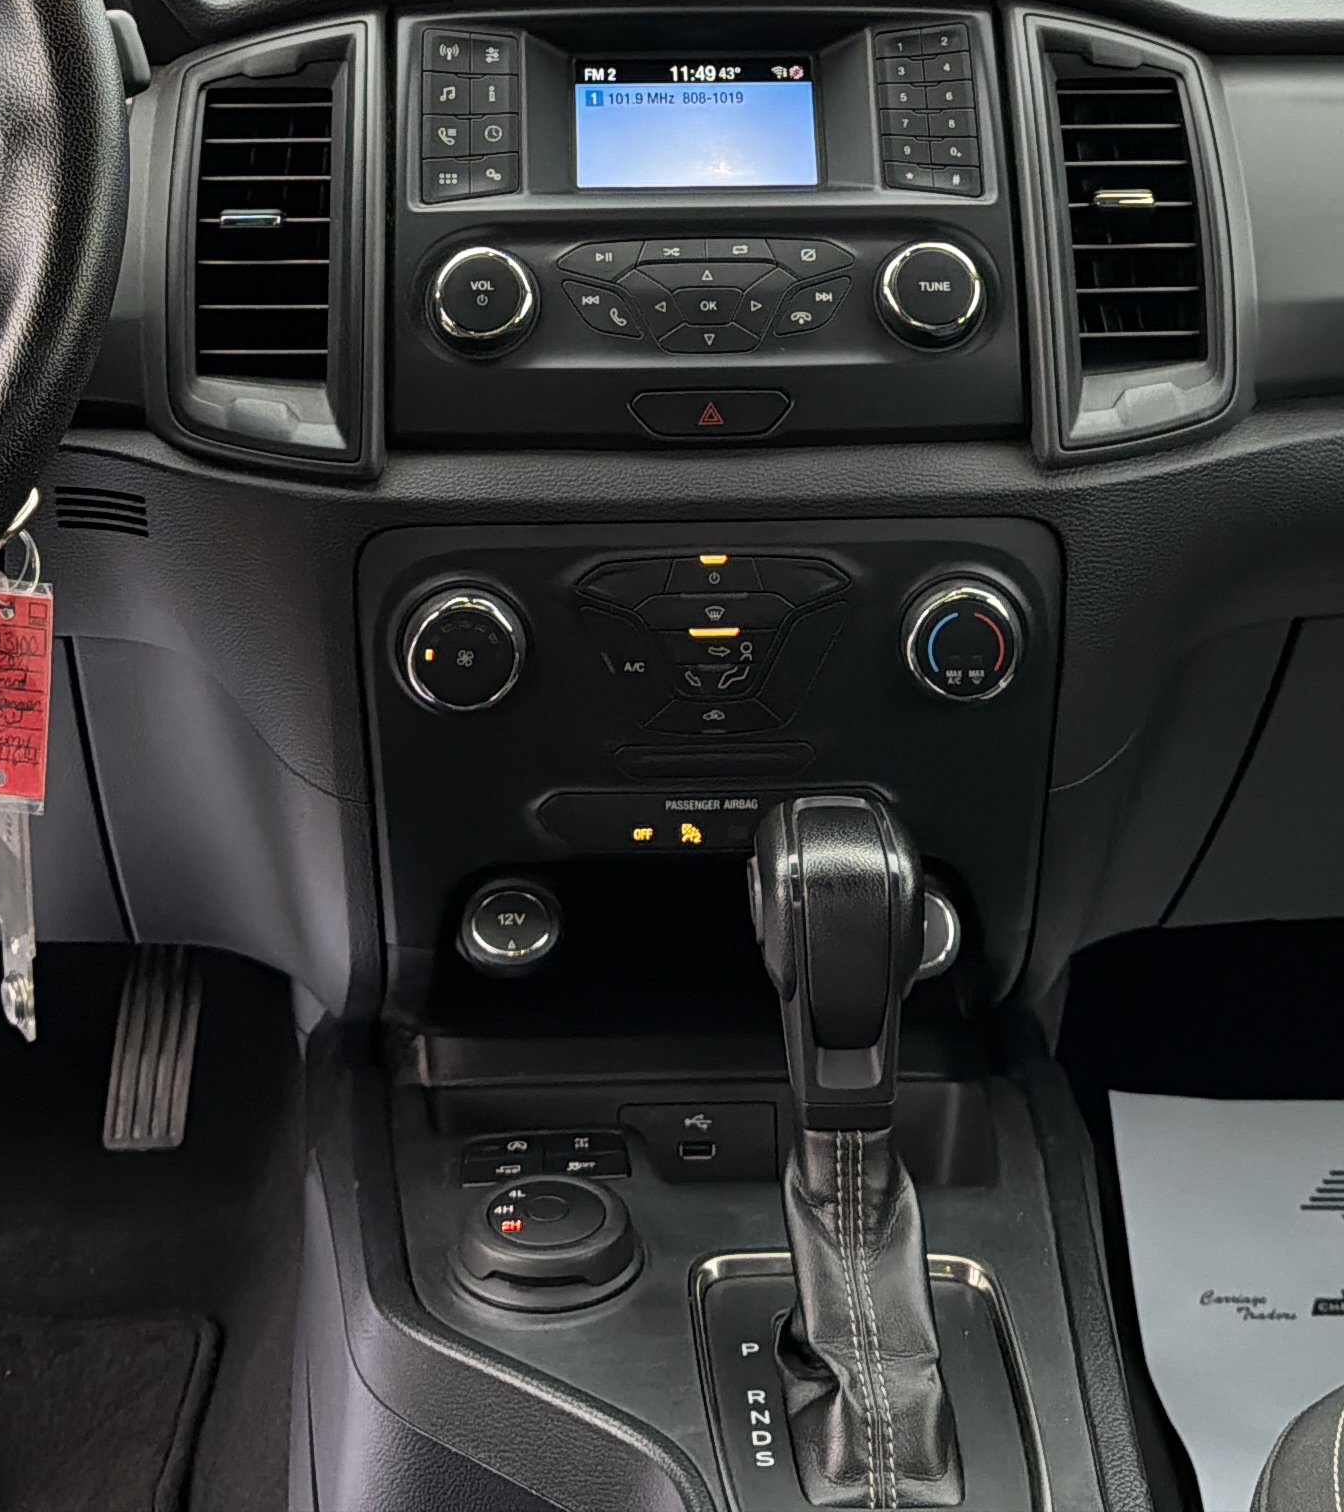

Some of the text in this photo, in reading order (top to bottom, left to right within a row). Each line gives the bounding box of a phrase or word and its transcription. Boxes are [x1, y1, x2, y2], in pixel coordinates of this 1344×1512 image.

[896, 41, 905, 52] 1
[940, 35, 949, 47] 2
[669, 64, 716, 82] 11:49
[896, 65, 905, 77] 3
[942, 61, 951, 73] 4
[583, 66, 617, 82] FM 2
[607, 91, 644, 107] 101.9
[646, 91, 676, 107] MHz
[681, 90, 744, 107] 808-1019
[899, 91, 907, 103] 5
[944, 90, 953, 102] 6
[901, 118, 909, 129] 7
[947, 118, 956, 130] 8
[903, 145, 911, 156] 9
[469, 280, 495, 292] VOL
[918, 281, 952, 293] TUNE
[699, 300, 719, 312] OK
[623, 660, 646, 674] A/C
[665, 798, 759, 811] PASSENGER AIRBAG
[632, 827, 654, 842] OFF
[496, 912, 527, 926] 12V
[508, 1189, 527, 1200] 4L
[493, 1204, 515, 1215] 4H
[740, 1341, 761, 1357] P
[746, 1389, 767, 1406] R
[749, 1409, 772, 1426] N
[751, 1429, 773, 1447] D
[755, 1450, 776, 1468] S
